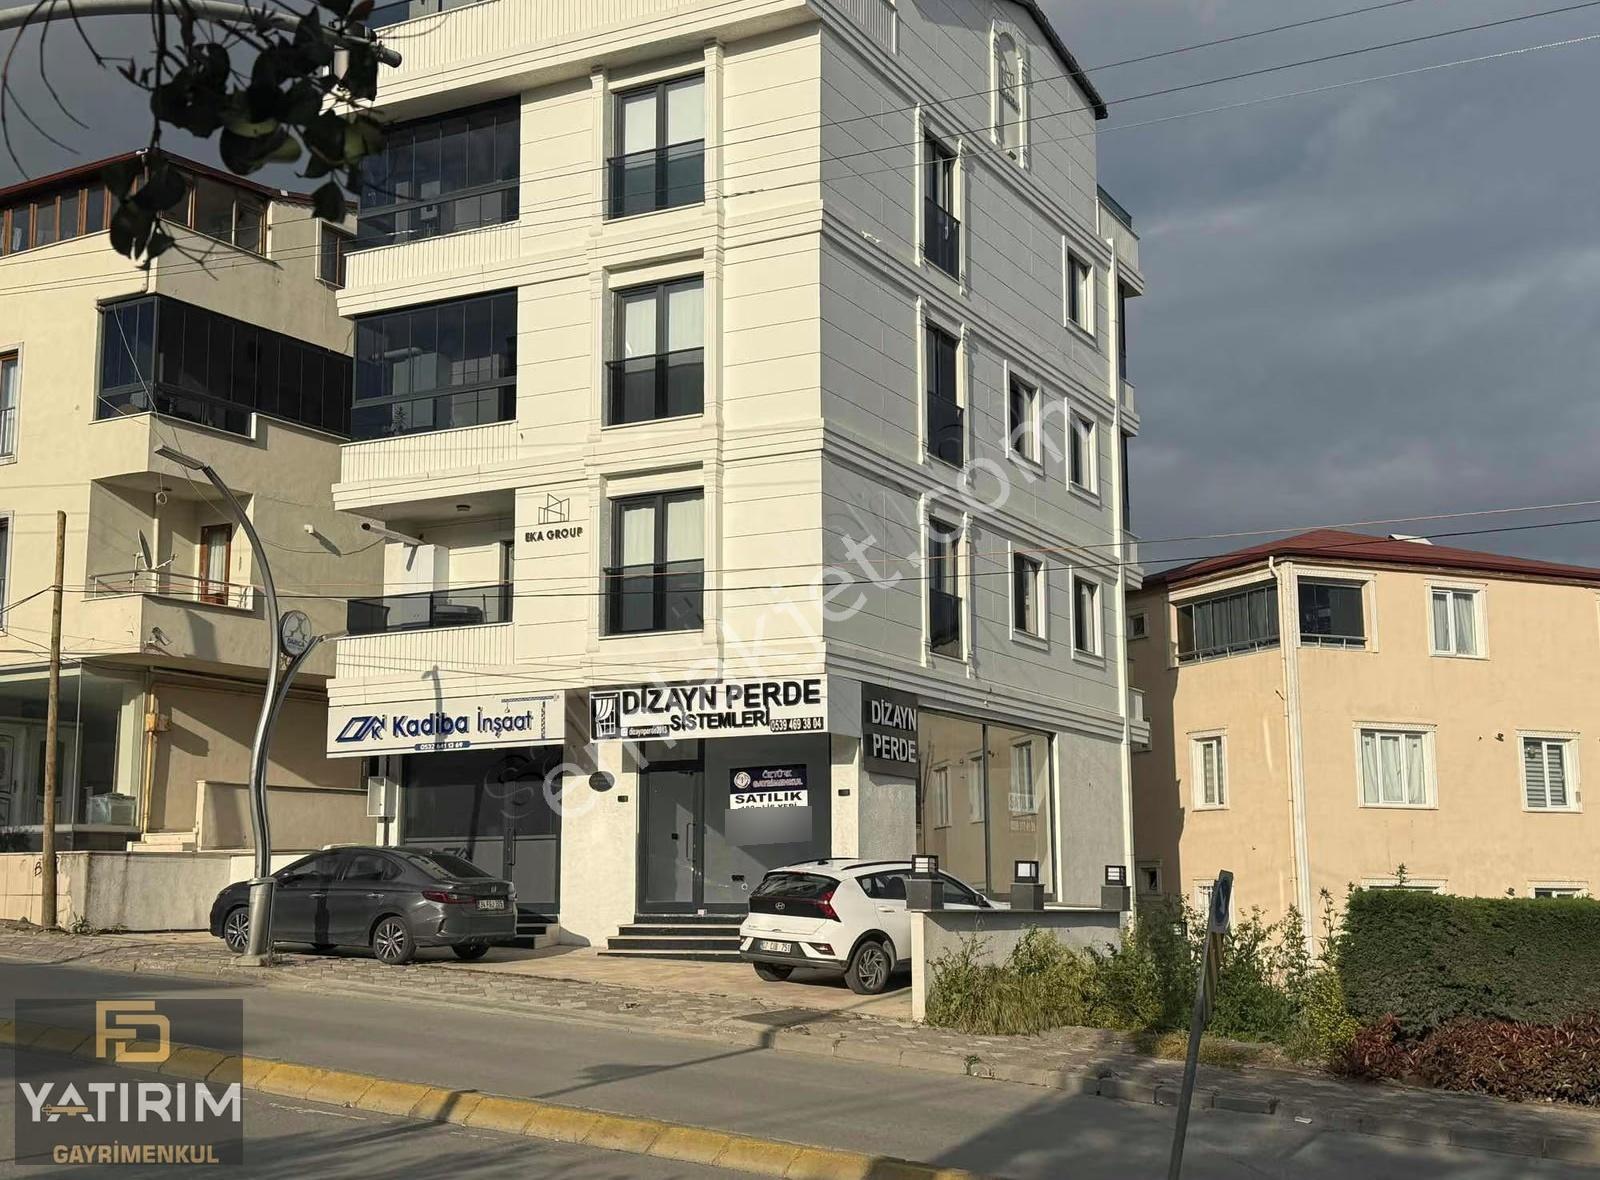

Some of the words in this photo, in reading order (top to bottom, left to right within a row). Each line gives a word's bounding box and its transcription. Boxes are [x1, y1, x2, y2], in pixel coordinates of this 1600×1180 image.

[525, 531, 545, 542] EKA
[546, 526, 584, 541] GROUP
[622, 684, 717, 715] DİZAYN
[726, 678, 822, 710] PERDE
[392, 711, 469, 739] Kadiba
[477, 705, 534, 739] İnşaat
[770, 719, 788, 731] 0539
[788, 718, 802, 730] 469
[802, 717, 812, 730] 38
[812, 717, 822, 729] 04
[871, 699, 917, 731] DİZAYN
[872, 732, 917, 763] PERDE
[735, 791, 802, 804] SATILIK
